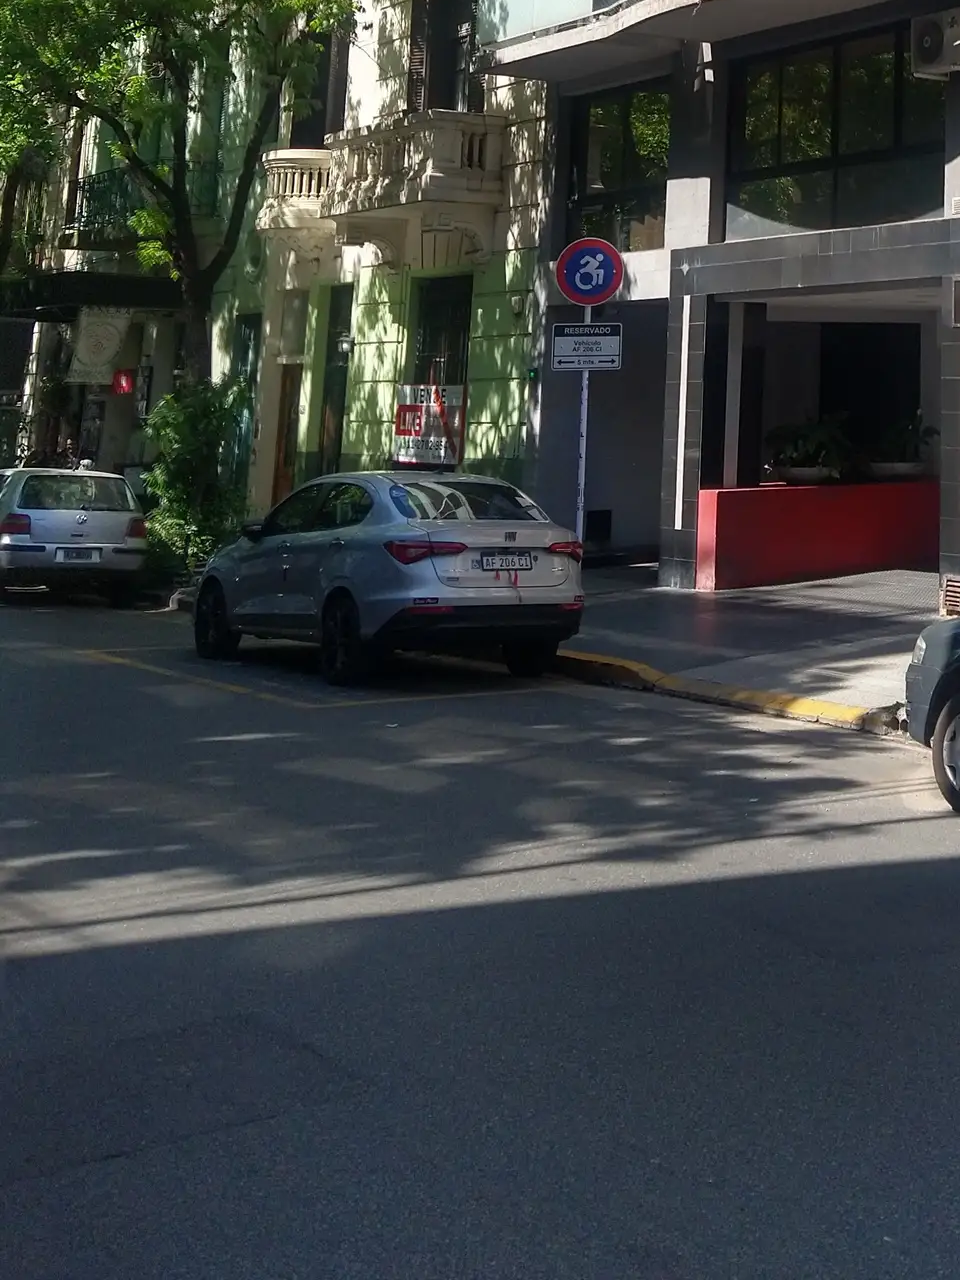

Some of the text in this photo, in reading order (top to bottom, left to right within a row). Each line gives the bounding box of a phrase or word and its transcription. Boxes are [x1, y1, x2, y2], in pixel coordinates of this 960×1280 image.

[564, 327, 611, 335] RESERVADO
[413, 388, 447, 405] VENE
[400, 411, 421, 431] LIKE
[485, 557, 529, 568] AF 206 CI
